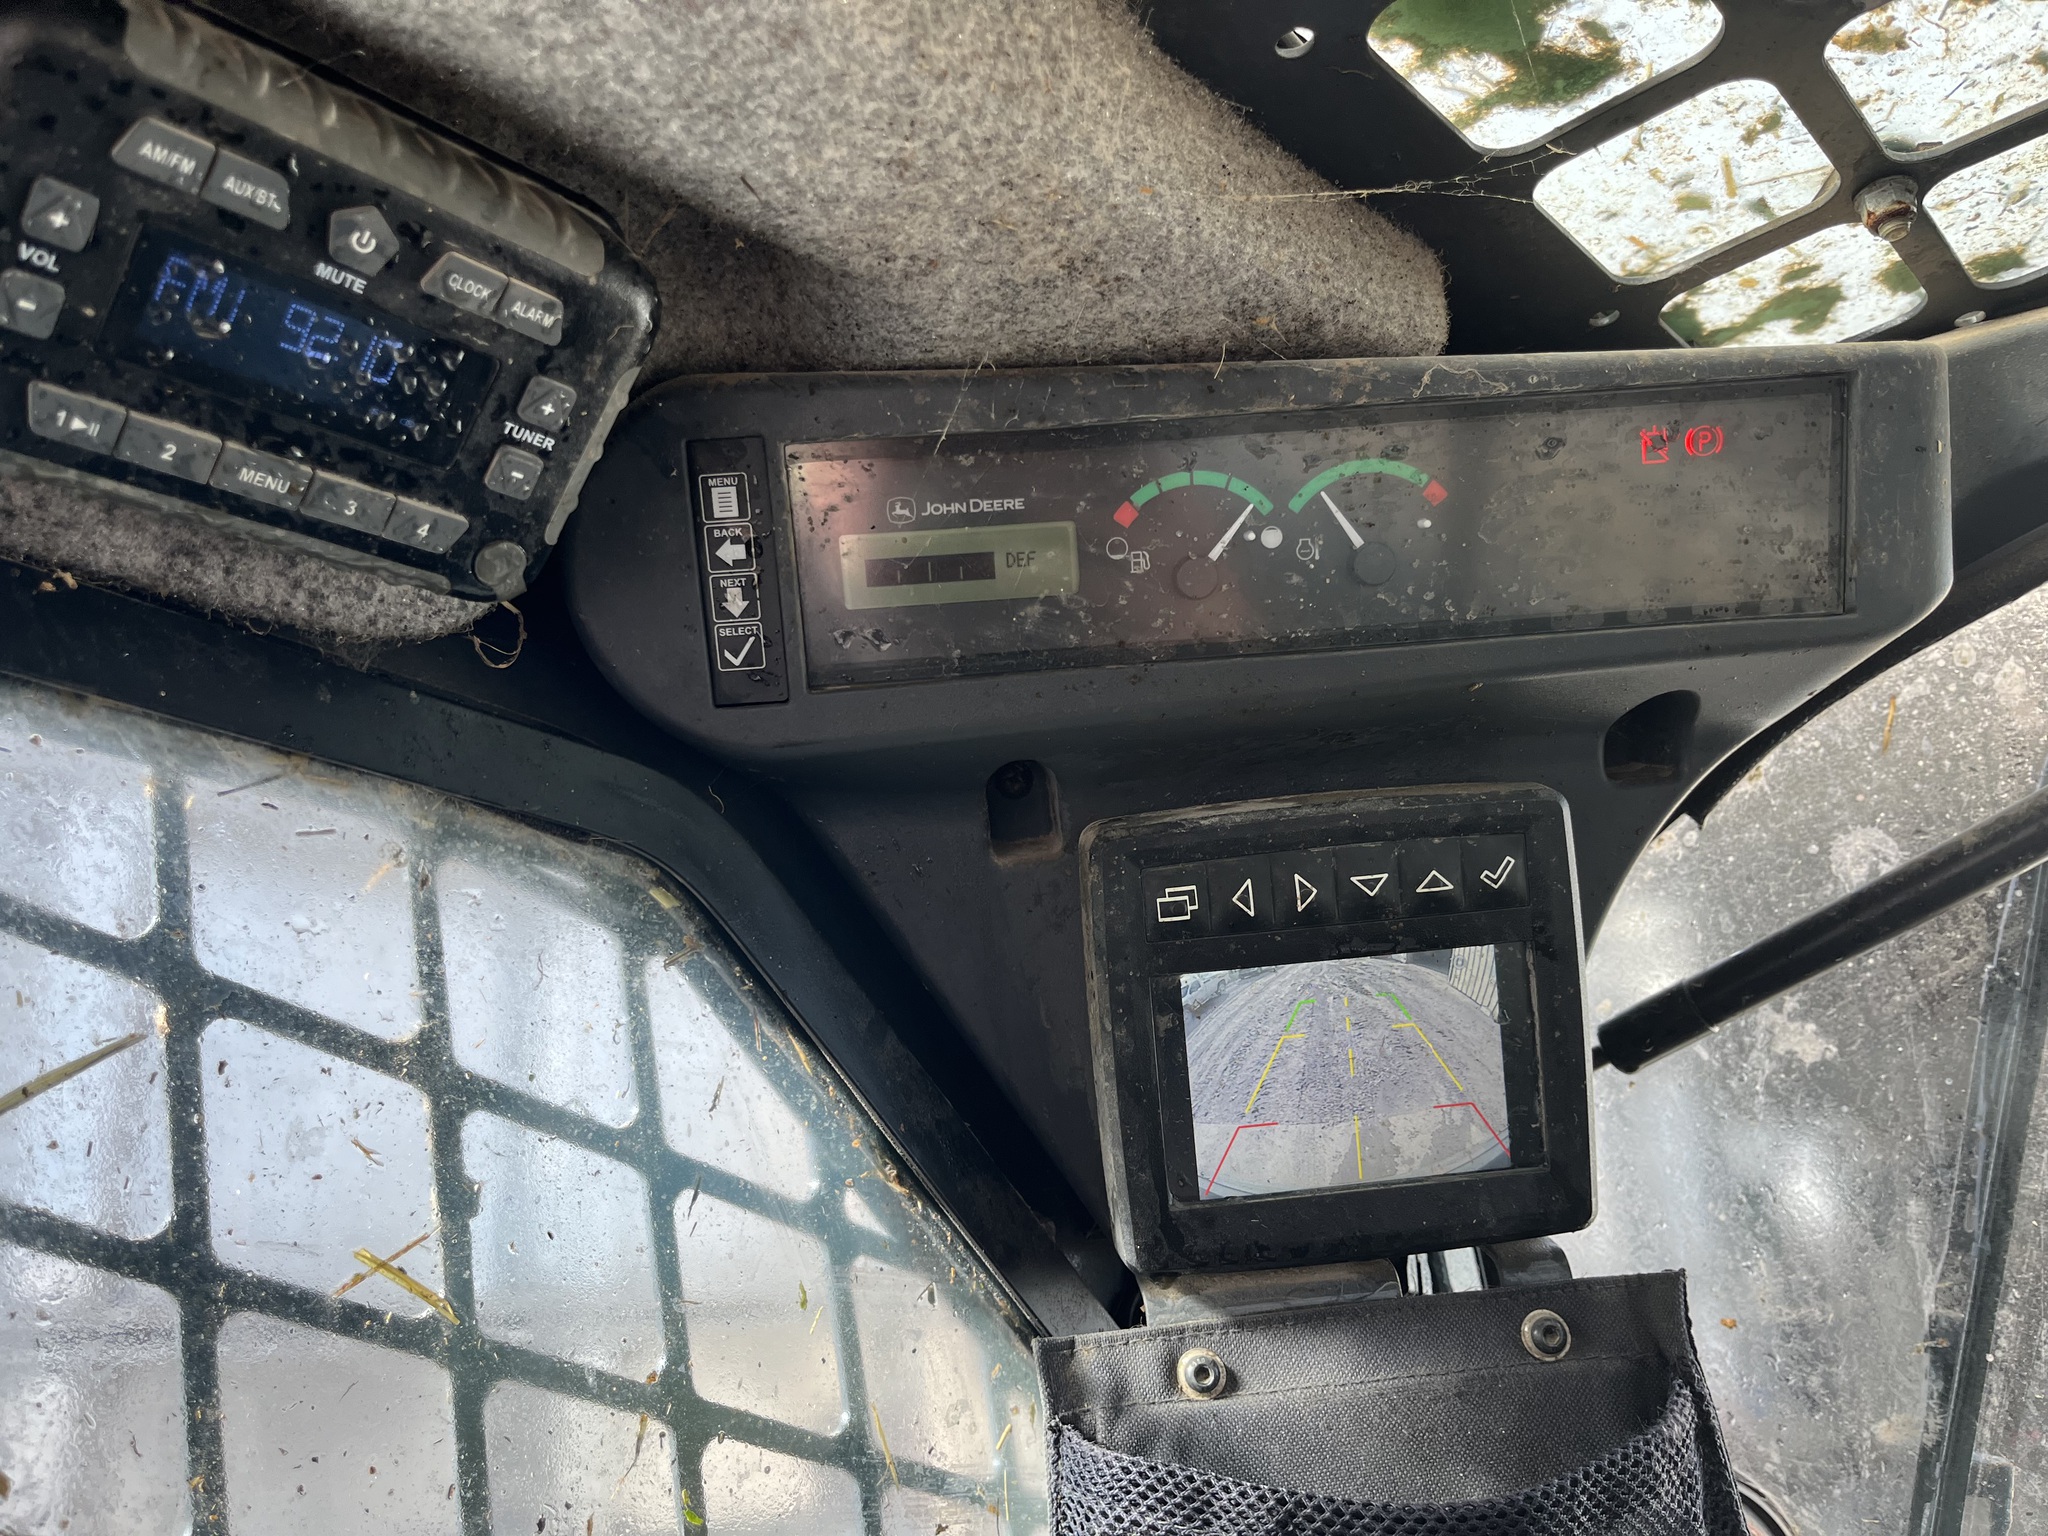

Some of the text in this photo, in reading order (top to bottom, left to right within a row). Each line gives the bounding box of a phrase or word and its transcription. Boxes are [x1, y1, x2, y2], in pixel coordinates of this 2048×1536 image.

[138, 141, 196, 176] AM/FM
[18, 242, 59, 273] VOL
[314, 262, 368, 295] MUTE
[448, 273, 492, 301] CLOCK
[511, 301, 554, 328] ALARM
[56, 410, 66, 427] 1
[503, 421, 556, 452] TUNER
[161, 444, 176, 461] 2
[238, 467, 291, 494] MENU
[708, 477, 738, 487] MENU
[344, 500, 358, 516] 3
[921, 498, 1025, 517] JOHN DEERE
[416, 523, 430, 538] 4
[713, 528, 743, 538] BACK
[1005, 550, 1036, 569] DEF
[719, 578, 747, 588] NEXT
[719, 626, 758, 637] SELECT
